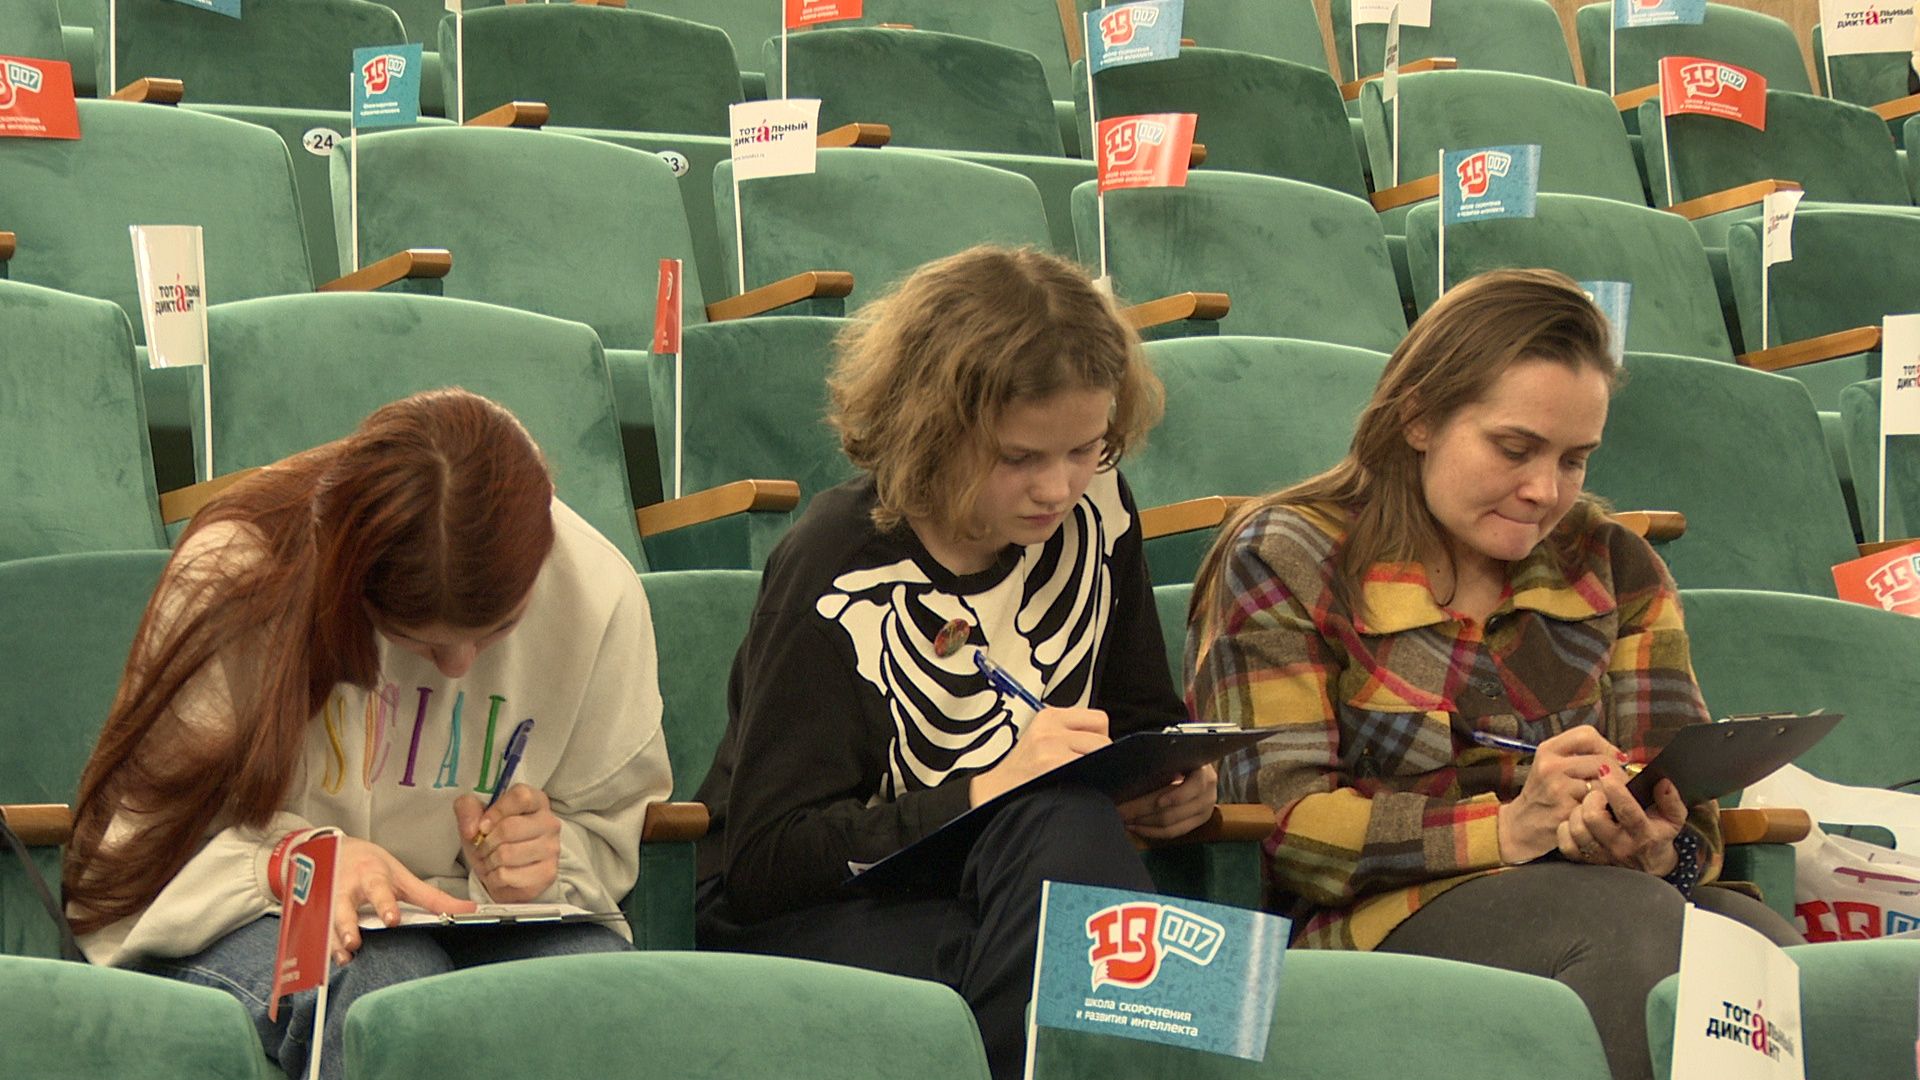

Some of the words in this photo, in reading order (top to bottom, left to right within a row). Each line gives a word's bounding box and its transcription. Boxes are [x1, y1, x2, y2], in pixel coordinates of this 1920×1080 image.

[10, 66, 39, 86] 007
[1720, 69, 1744, 86] 007
[314, 134, 334, 149] 24
[1795, 900, 1882, 943] IQ
[1162, 914, 1216, 952] 007
